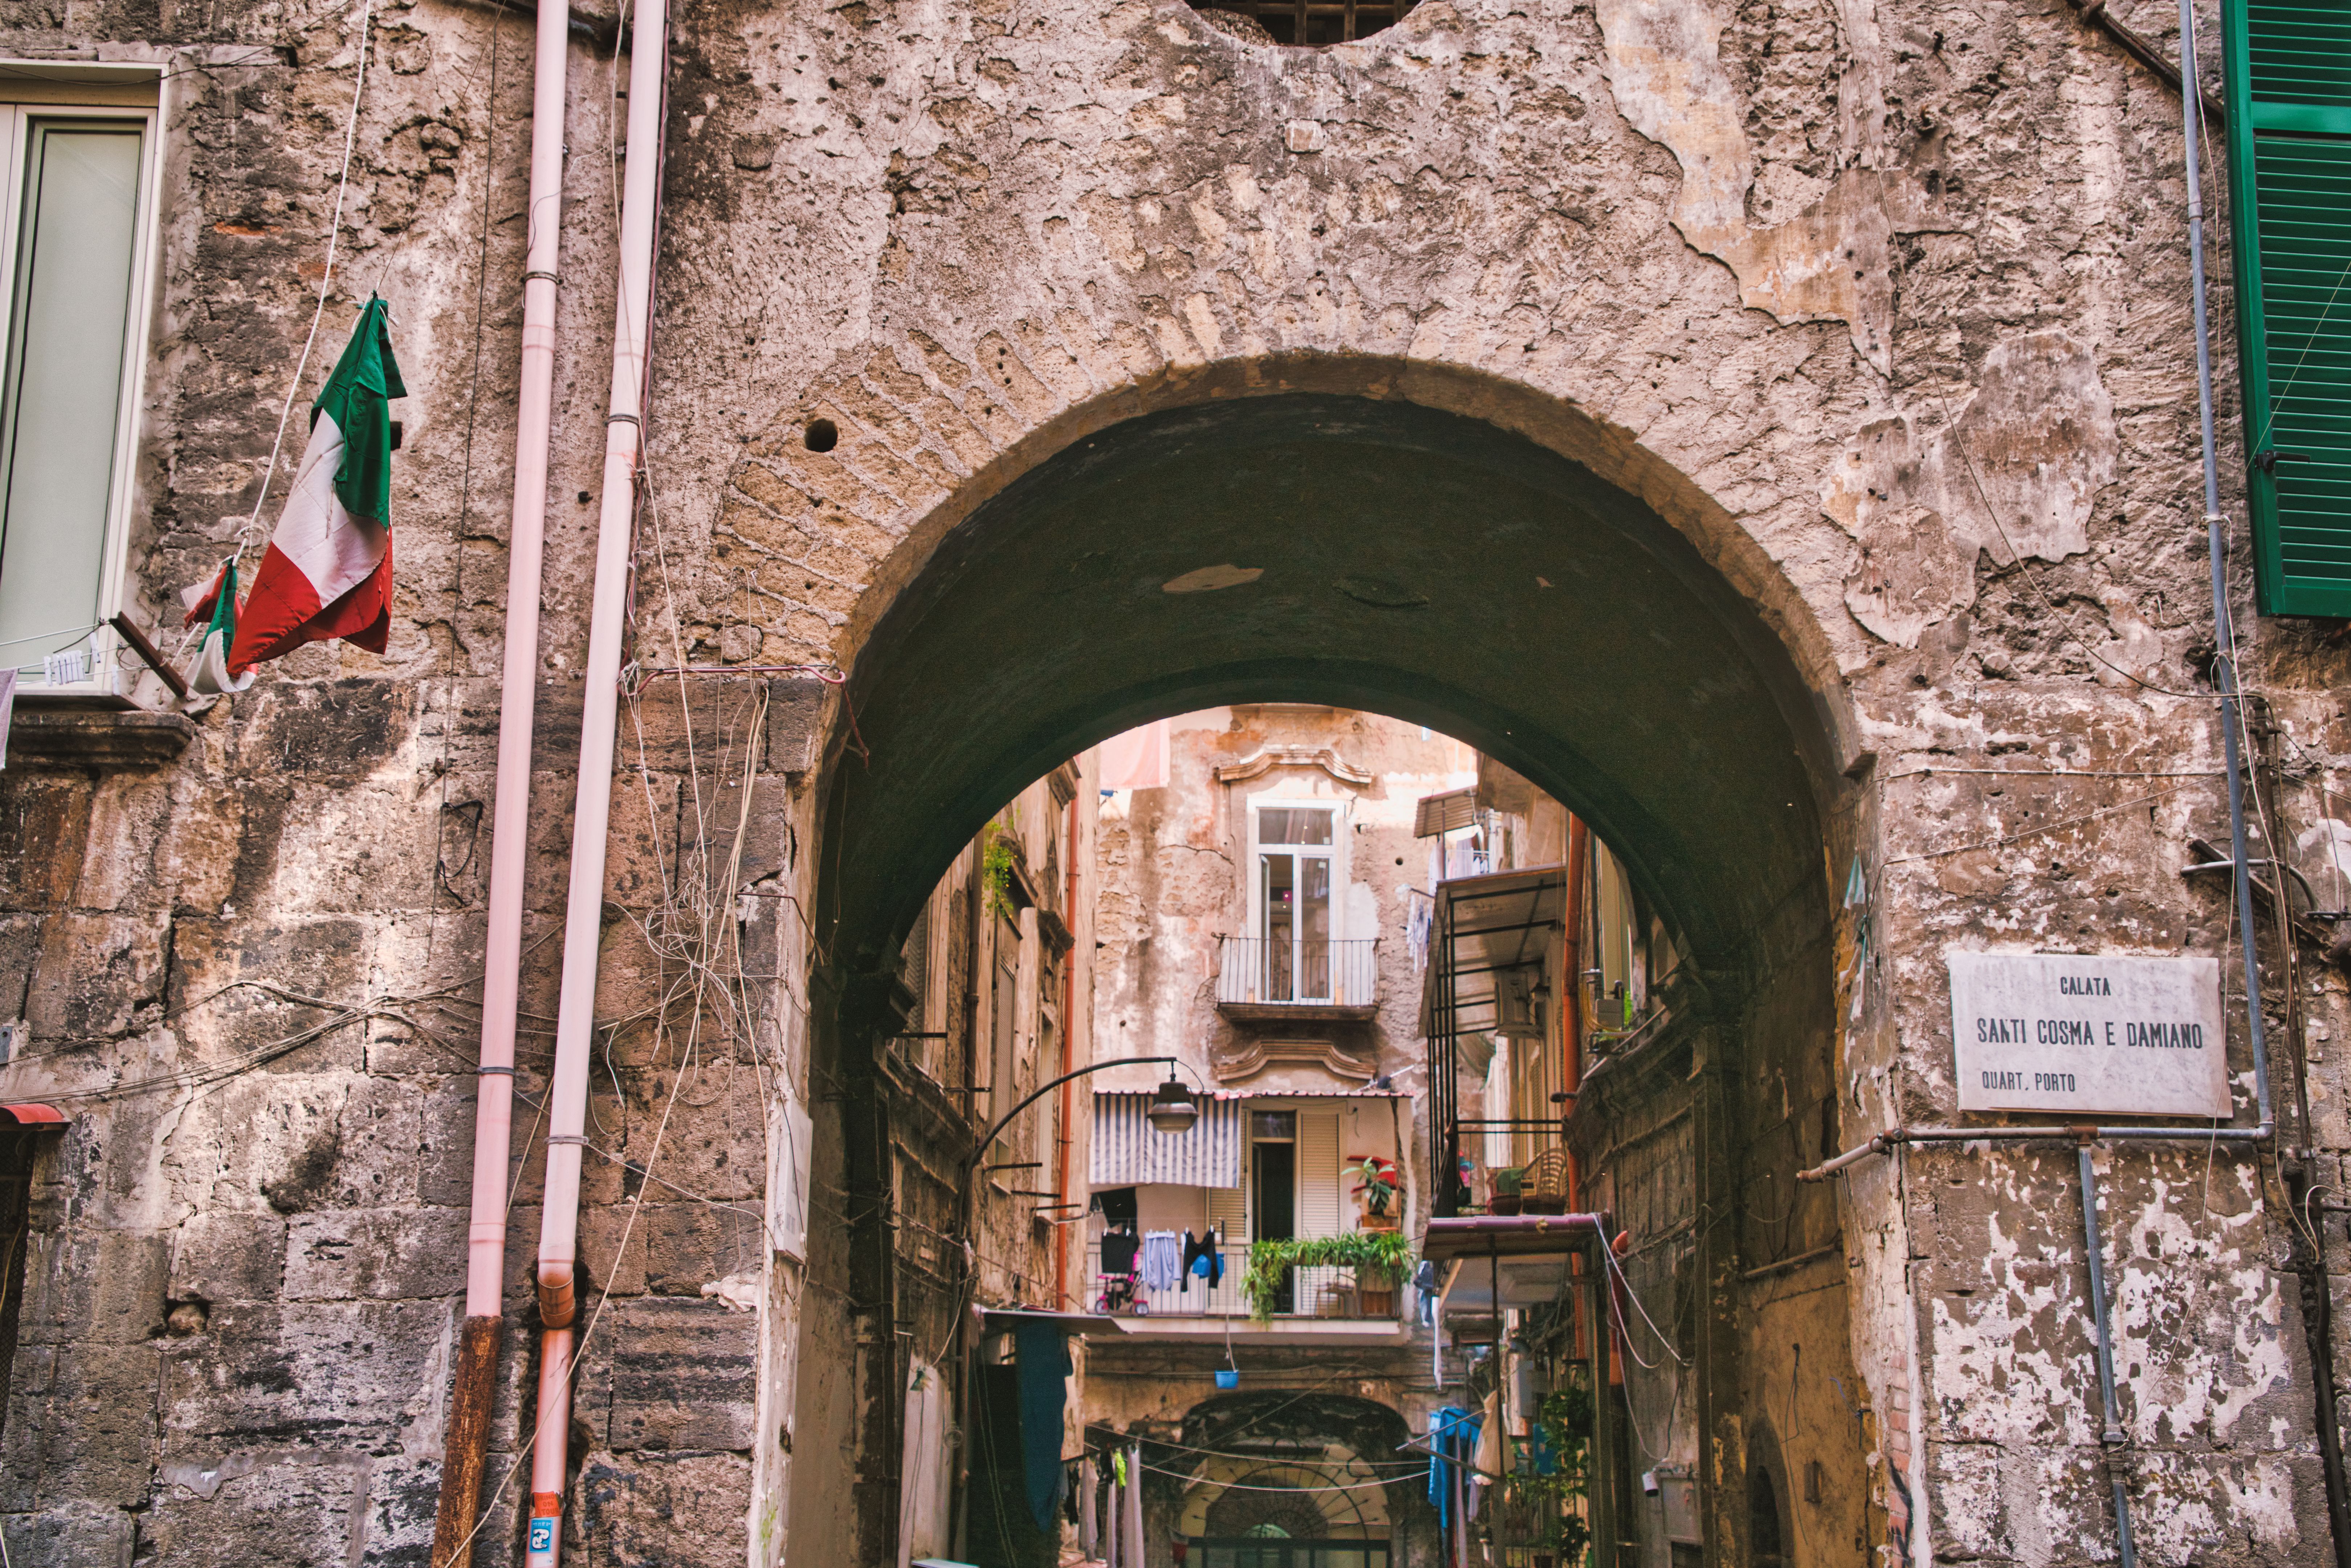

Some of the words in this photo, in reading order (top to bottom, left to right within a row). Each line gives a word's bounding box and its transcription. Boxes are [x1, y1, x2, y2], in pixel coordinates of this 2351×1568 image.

[2060, 977, 2111, 996] CALATA
[1977, 1018, 2026, 1043] SANTI
[2037, 1020, 2094, 1045] COSMA
[2105, 1021, 2115, 1046] E
[2126, 1022, 2203, 1049] DAMIANO
[2035, 1073, 2075, 1092] PORTO
